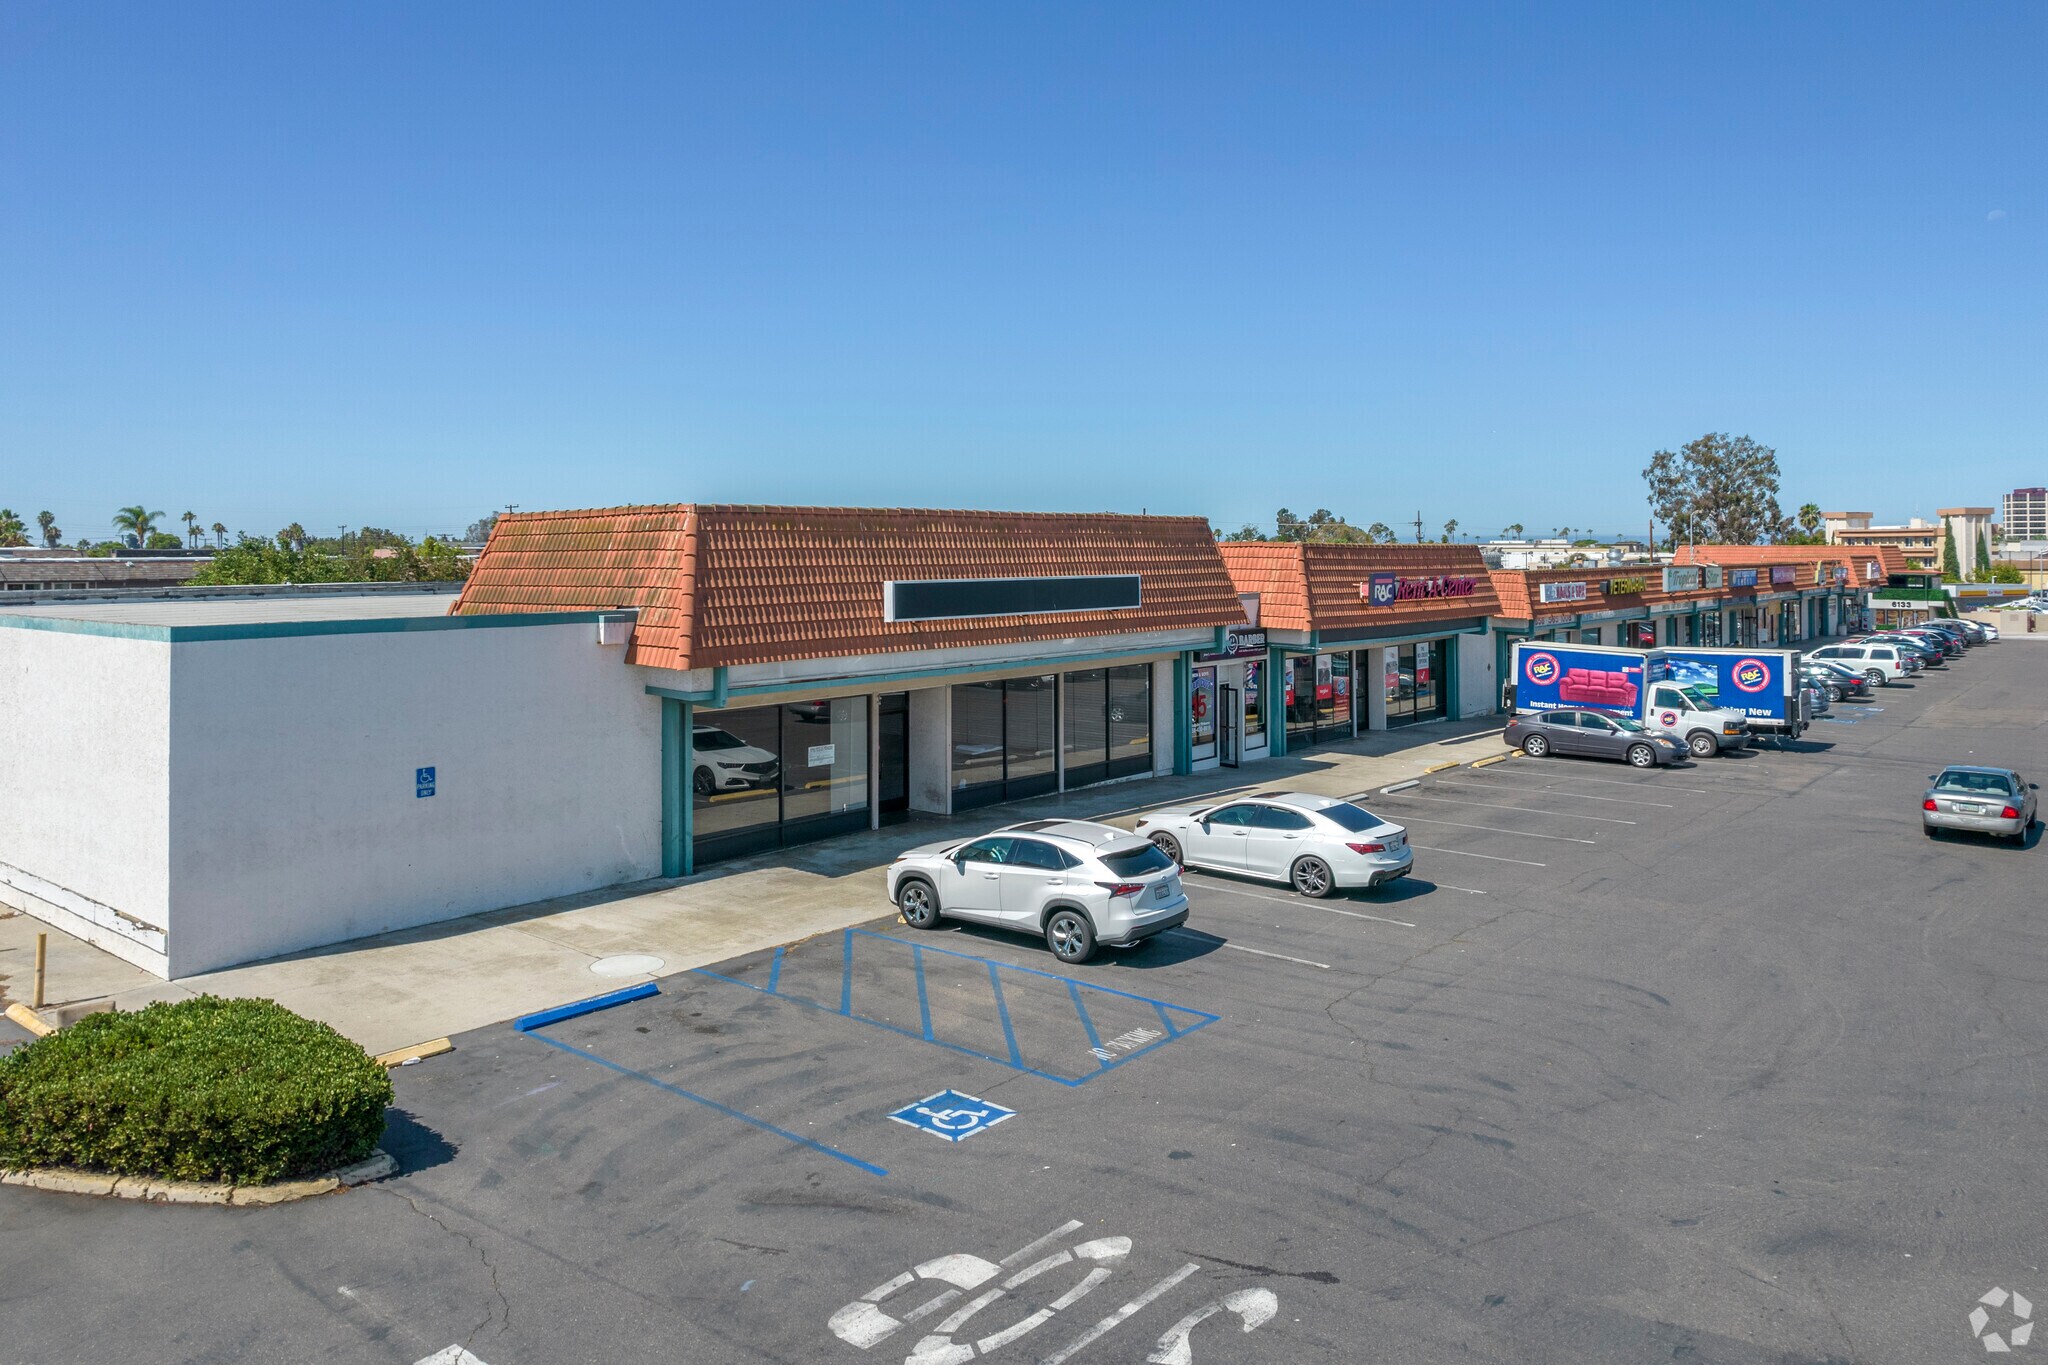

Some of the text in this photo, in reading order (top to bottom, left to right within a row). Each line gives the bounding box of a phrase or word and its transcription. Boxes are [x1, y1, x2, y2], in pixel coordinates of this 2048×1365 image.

[1672, 570, 1697, 588] Tropical
[1706, 568, 1719, 584] Star
[1374, 584, 1393, 602] RAC
[1239, 633, 1265, 646] BARBER
[1533, 663, 1552, 674] RAC
[1741, 669, 1761, 681] RAC
[1530, 701, 1557, 709] Instant
[1749, 708, 1772, 717] New
[1086, 1027, 1163, 1061] NO PARKING
